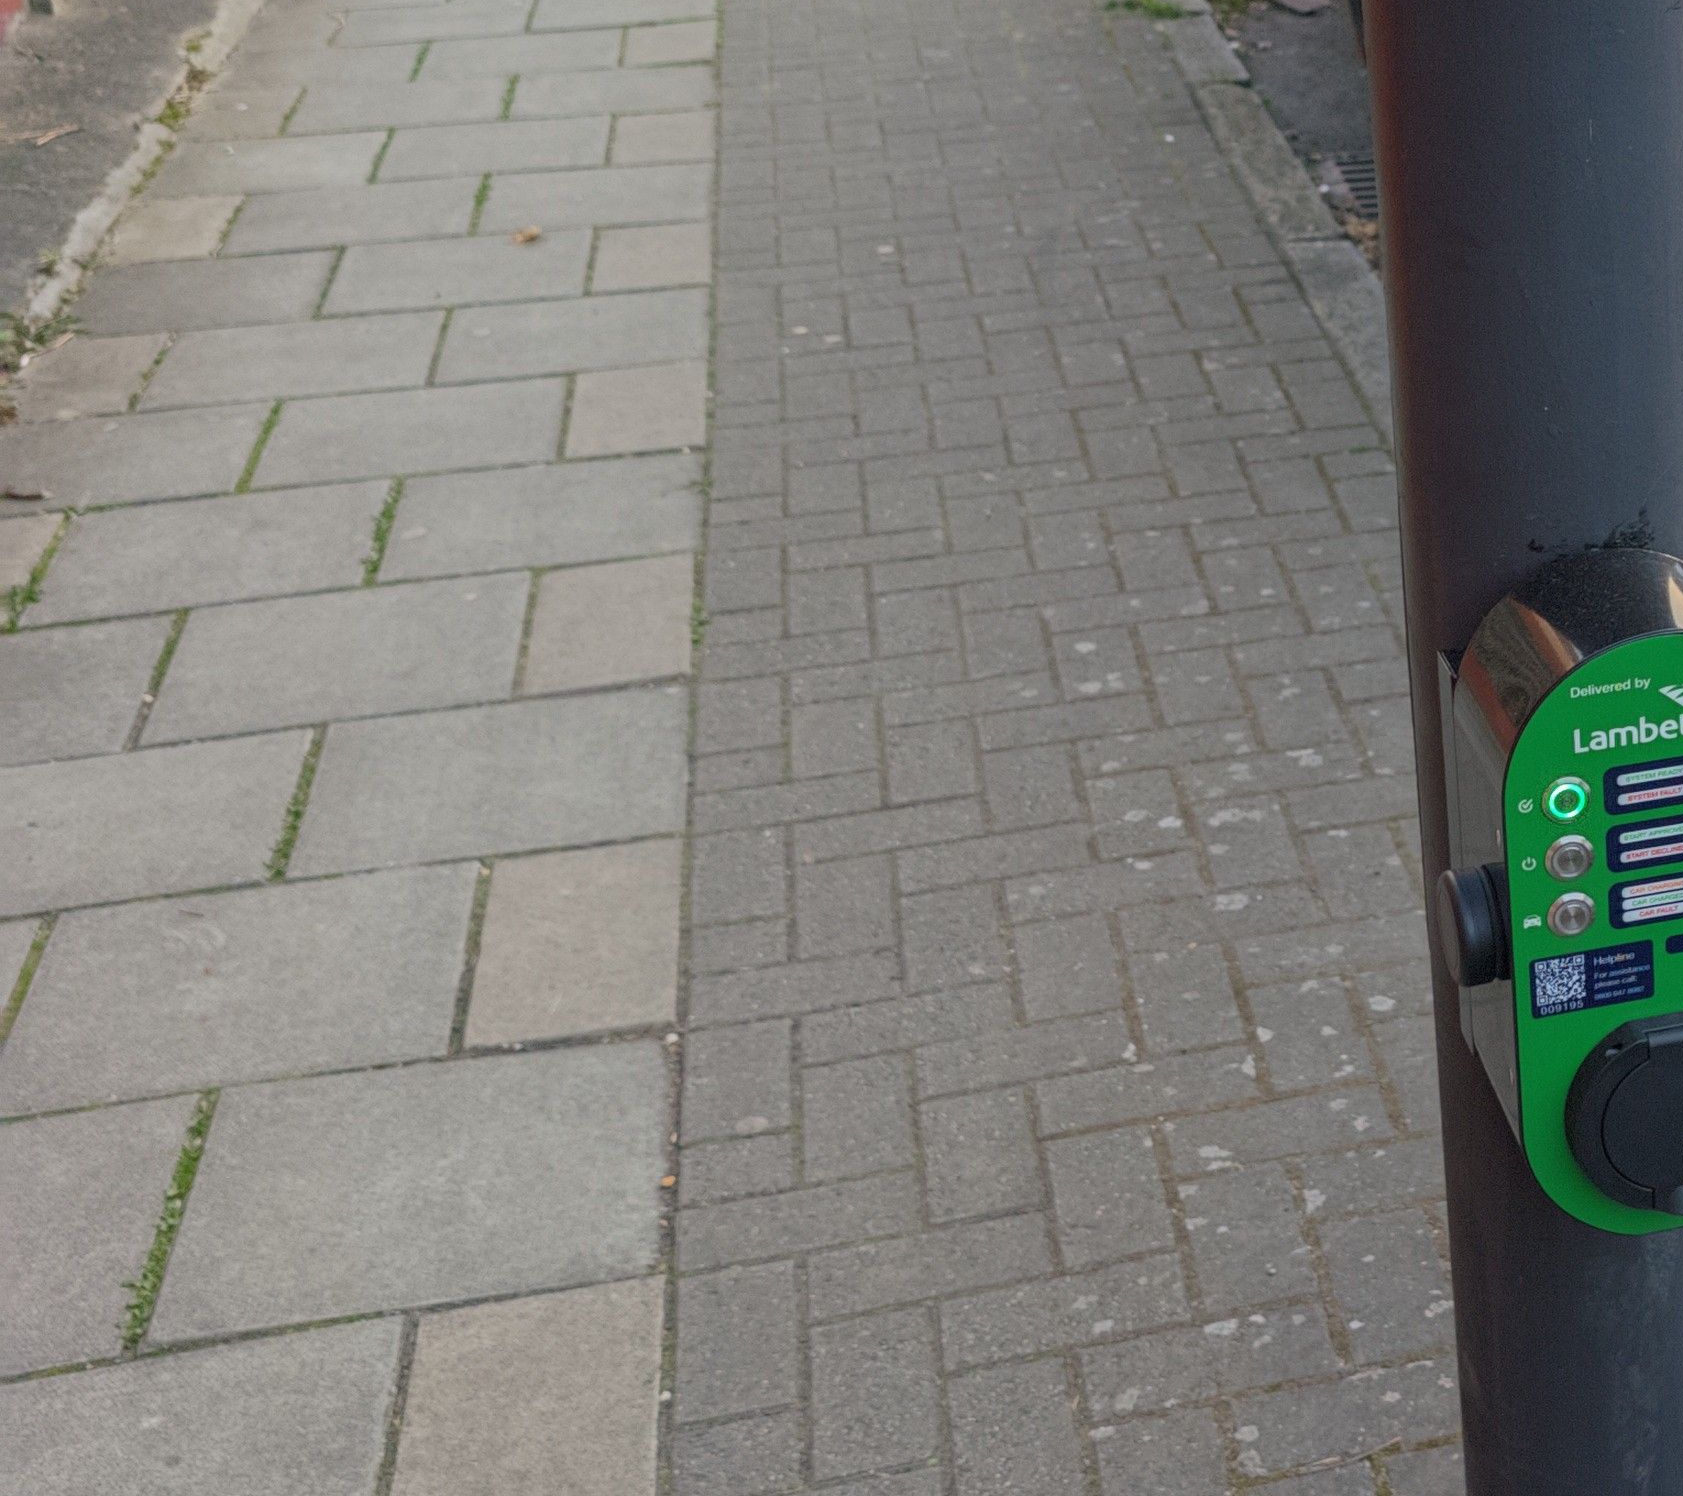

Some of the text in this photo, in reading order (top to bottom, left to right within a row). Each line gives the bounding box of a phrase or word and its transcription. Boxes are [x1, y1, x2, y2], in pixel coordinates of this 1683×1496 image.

[1570, 678, 1651, 698] Delivered by
[1625, 768, 1683, 783] SYSTEM READY
[1628, 787, 1682, 802] SYSTEM FAULT
[1624, 831, 1645, 841] START
[1626, 851, 1649, 860] START
[1630, 886, 1646, 895] CAR
[1632, 897, 1648, 907] CAR
[1639, 905, 1679, 917] CAR FAULT
[1594, 952, 1635, 966] Helpline
[1540, 1000, 1584, 1016] 009195
